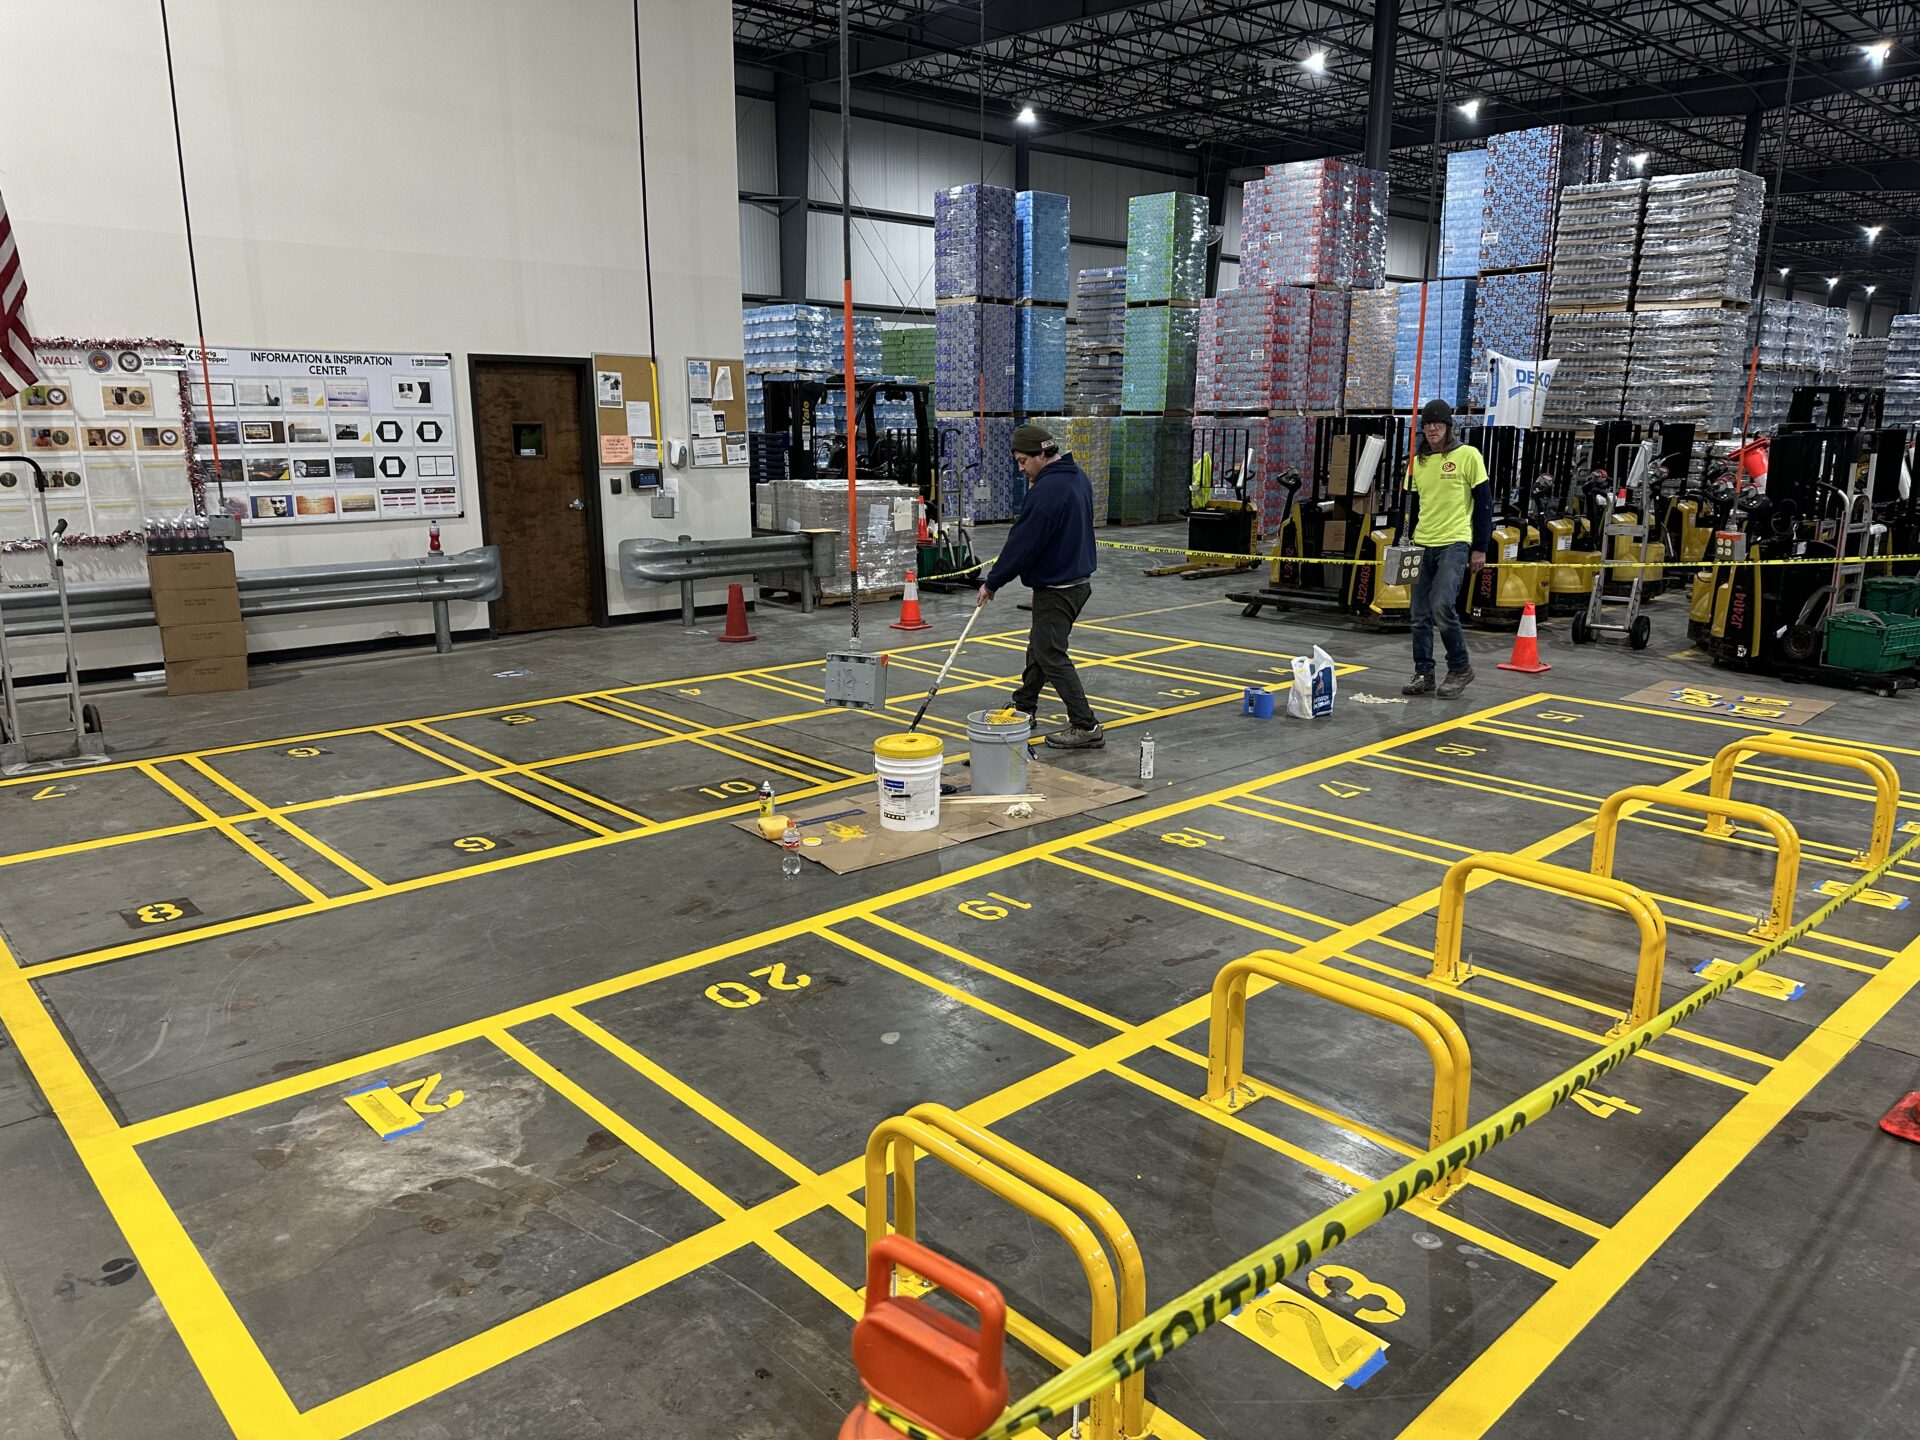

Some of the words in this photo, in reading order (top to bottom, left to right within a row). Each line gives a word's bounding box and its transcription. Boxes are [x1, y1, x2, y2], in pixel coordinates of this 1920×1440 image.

[42, 356, 77, 365] WALL
[251, 352, 322, 364] INFORMATION
[325, 355, 332, 363] &
[333, 355, 392, 366] INSPIRATION
[308, 365, 347, 375] CENTER
[1516, 368, 1551, 389] DEKO
[802, 400, 810, 424] Yale
[1157, 687, 1200, 699] 13
[501, 714, 536, 725] 5
[1537, 710, 1584, 723] 15
[287, 747, 321, 757] 6
[1435, 743, 1487, 757] 16
[32, 786, 66, 800] 7
[699, 781, 757, 799] 10
[1319, 781, 1371, 799] 17
[453, 836, 497, 853] 9
[1160, 826, 1225, 849] 18
[136, 902, 184, 923] 8
[958, 892, 1032, 930] 19
[704, 962, 811, 1008] 20
